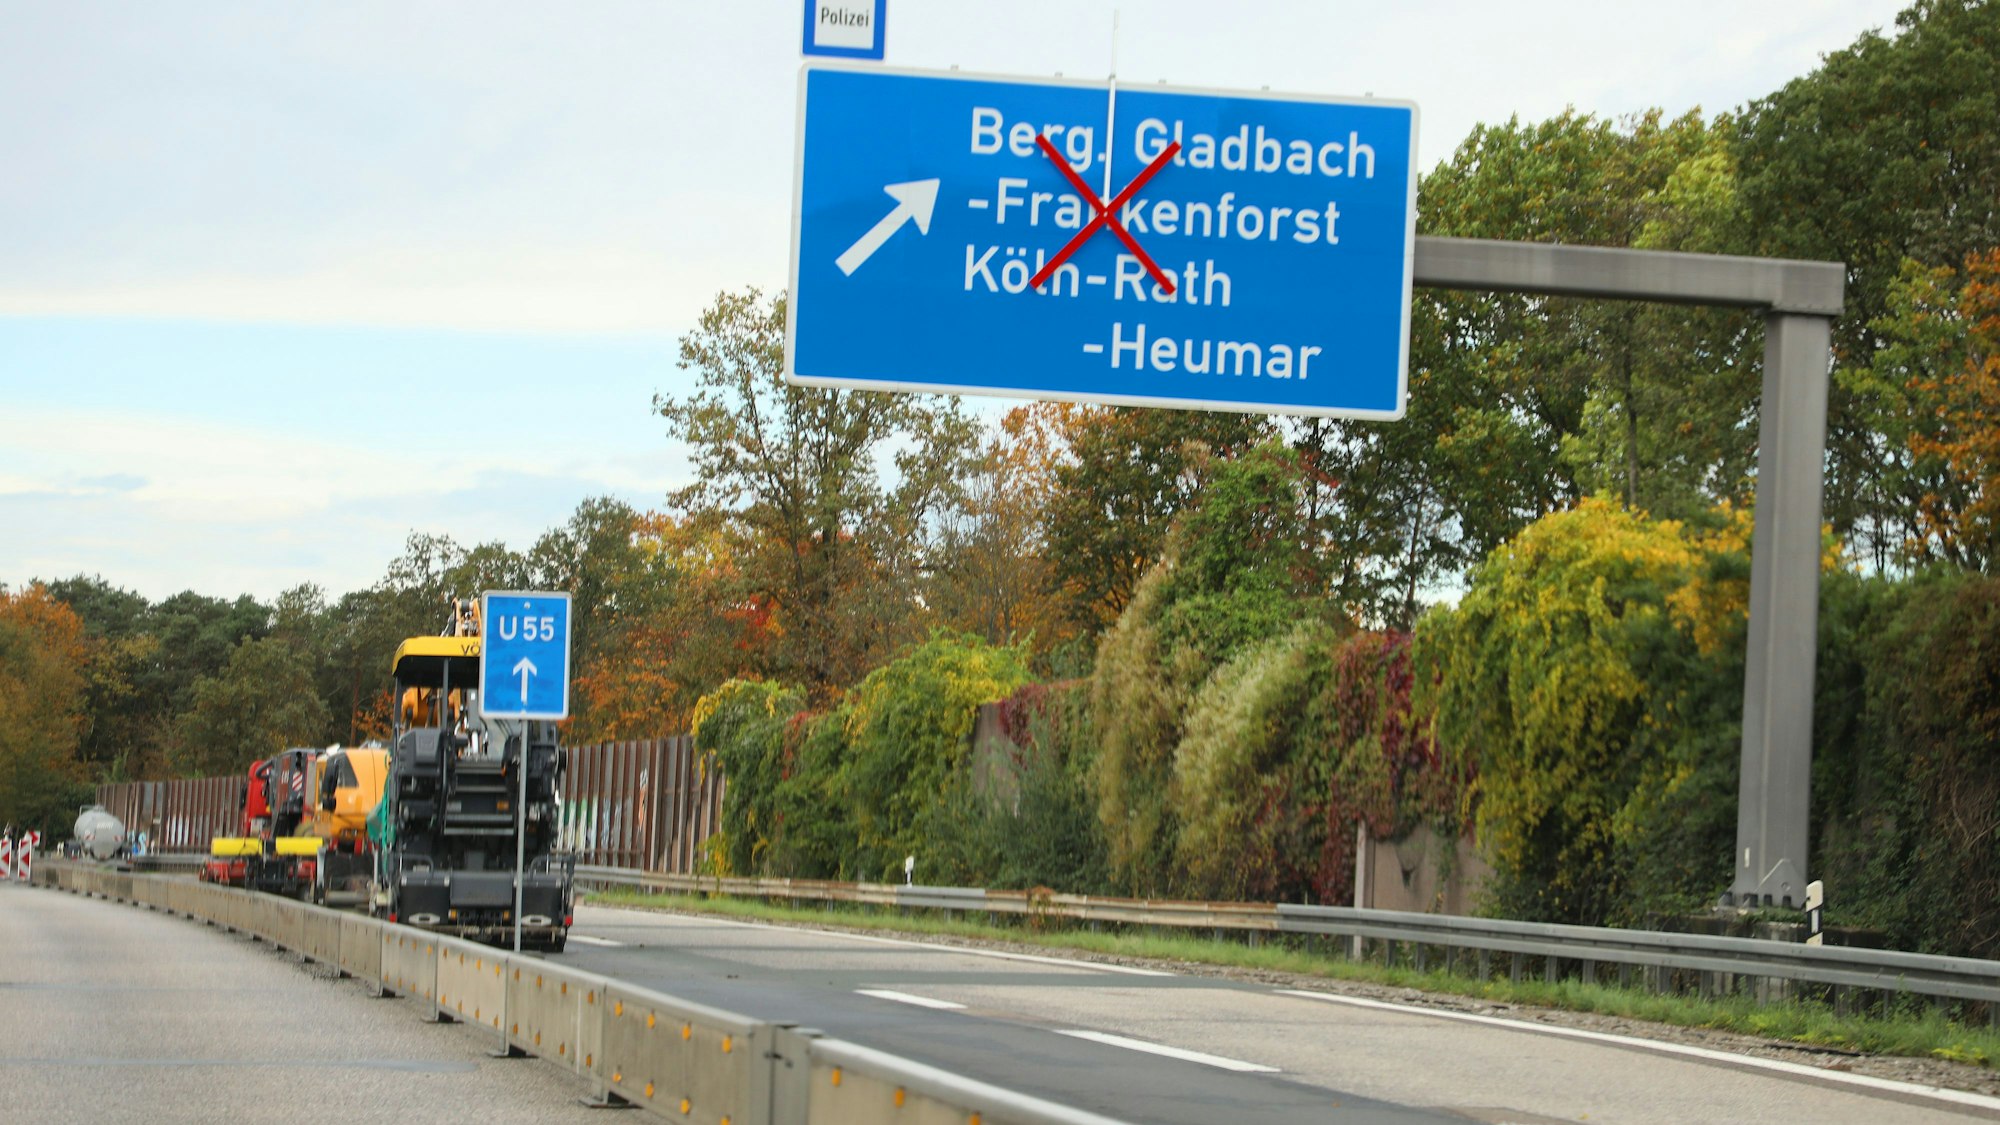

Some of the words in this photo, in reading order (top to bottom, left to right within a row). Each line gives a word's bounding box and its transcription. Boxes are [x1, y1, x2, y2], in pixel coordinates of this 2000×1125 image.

[820, 6, 870, 28] Polizei
[970, 106, 1107, 174] Berg.
[1134, 117, 1377, 180] Gladbach
[963, 243, 1232, 307] Köln-Rath
[1082, 322, 1323, 381] -Heumar
[499, 615, 518, 641] U
[523, 615, 555, 642] 55
